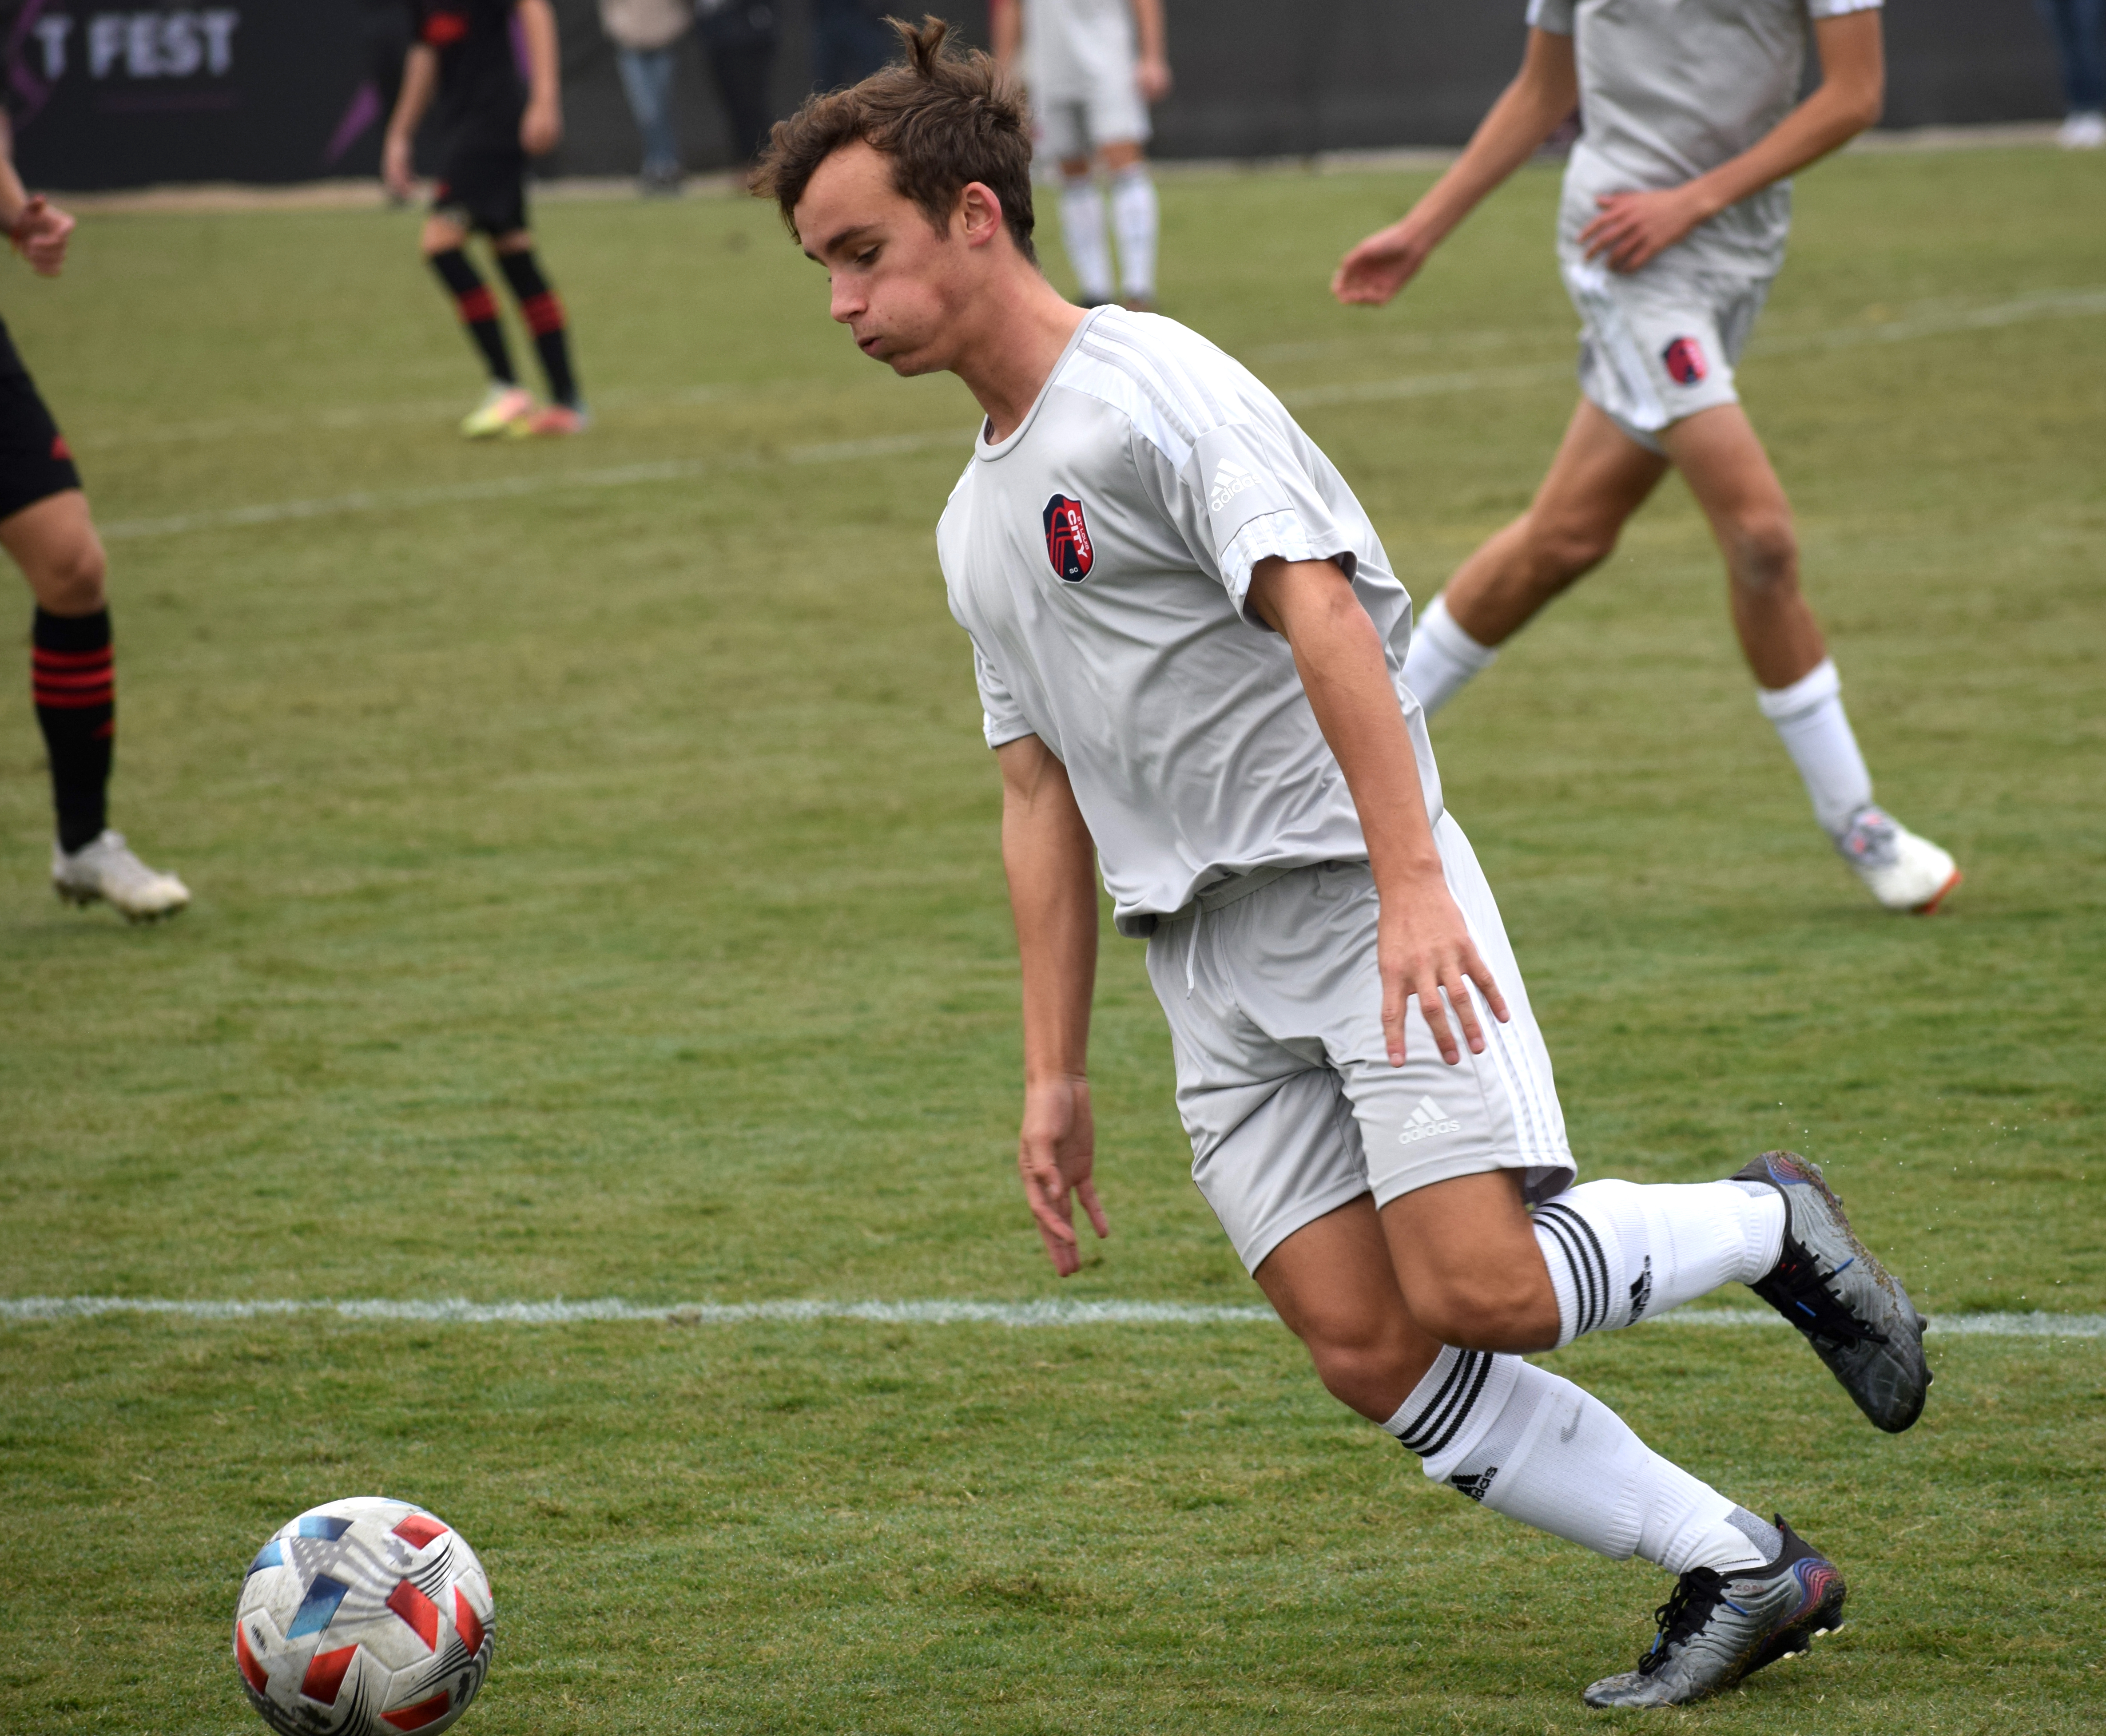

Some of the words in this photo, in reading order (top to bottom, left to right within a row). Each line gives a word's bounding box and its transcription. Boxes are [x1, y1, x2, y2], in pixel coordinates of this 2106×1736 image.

[87, 10, 239, 79] FEST
[1211, 473, 1264, 512] adidas
[1067, 509, 1088, 558] CITY
[1080, 528, 1090, 550] LOUIS
[1399, 1120, 1461, 1145] adidas
